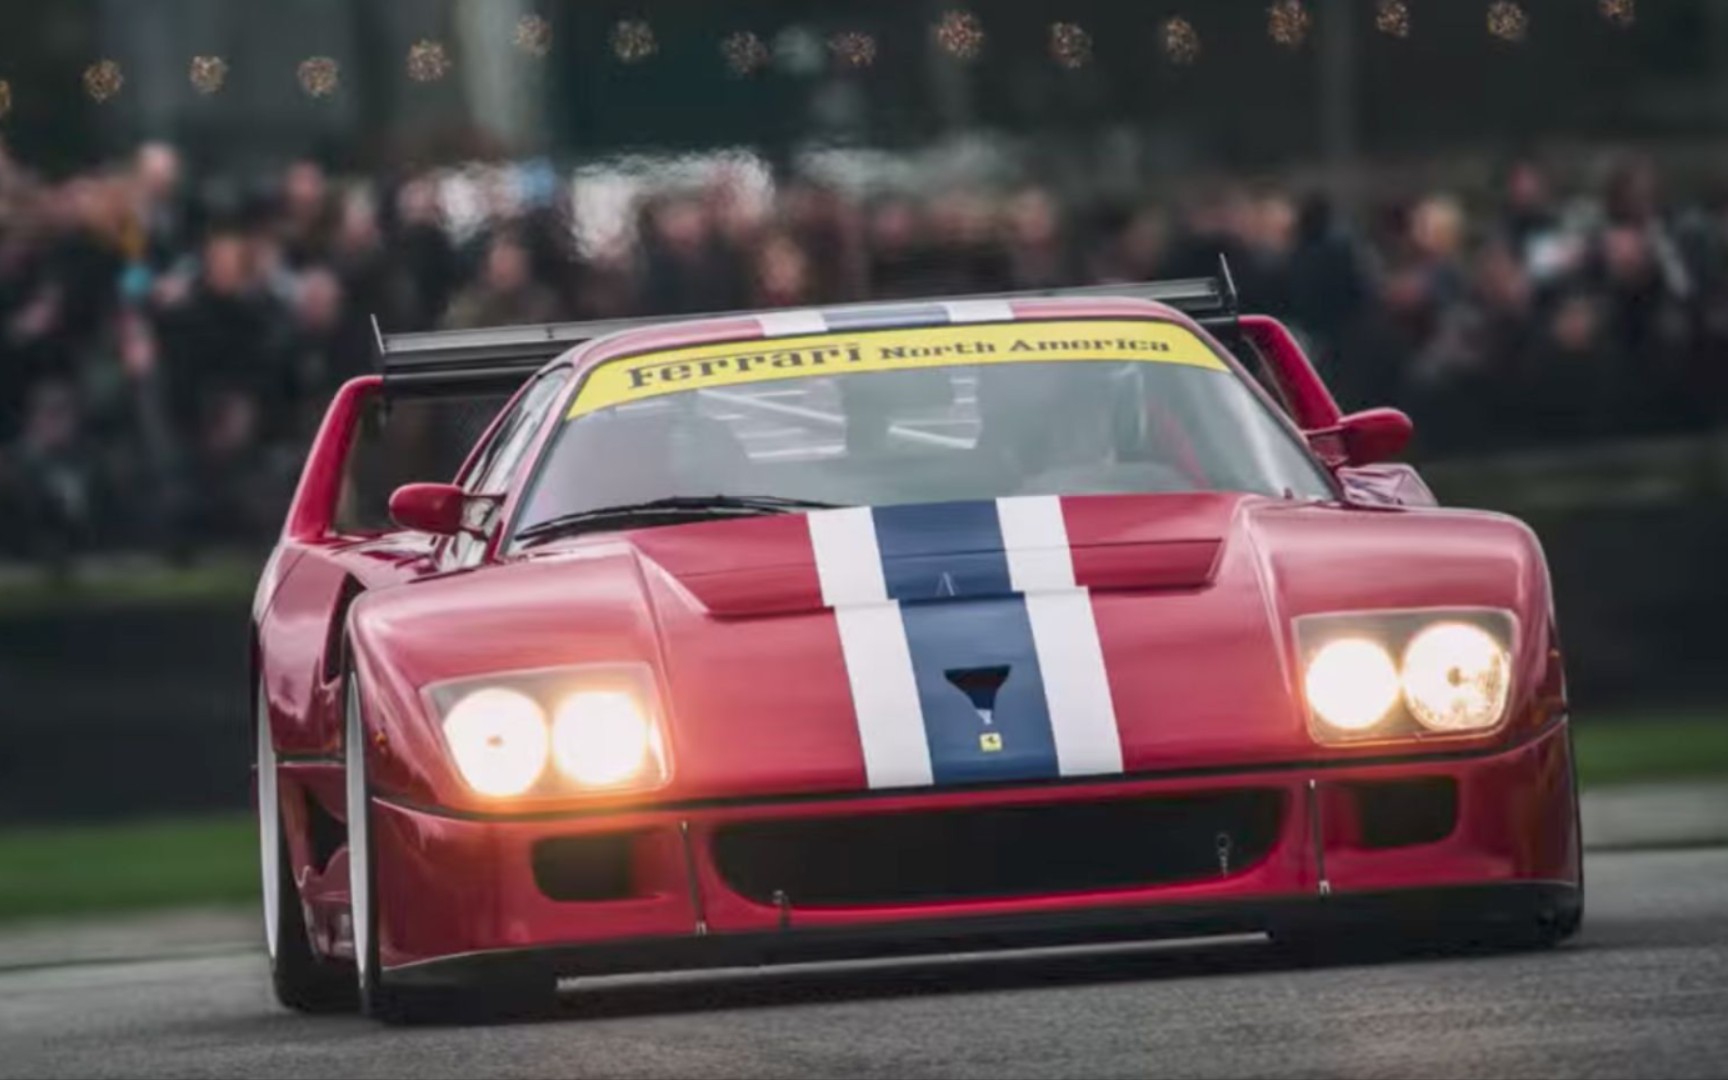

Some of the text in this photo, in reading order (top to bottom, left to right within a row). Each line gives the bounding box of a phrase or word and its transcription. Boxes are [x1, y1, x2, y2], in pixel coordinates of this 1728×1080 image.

[626, 337, 1171, 390] Ferrari North America
